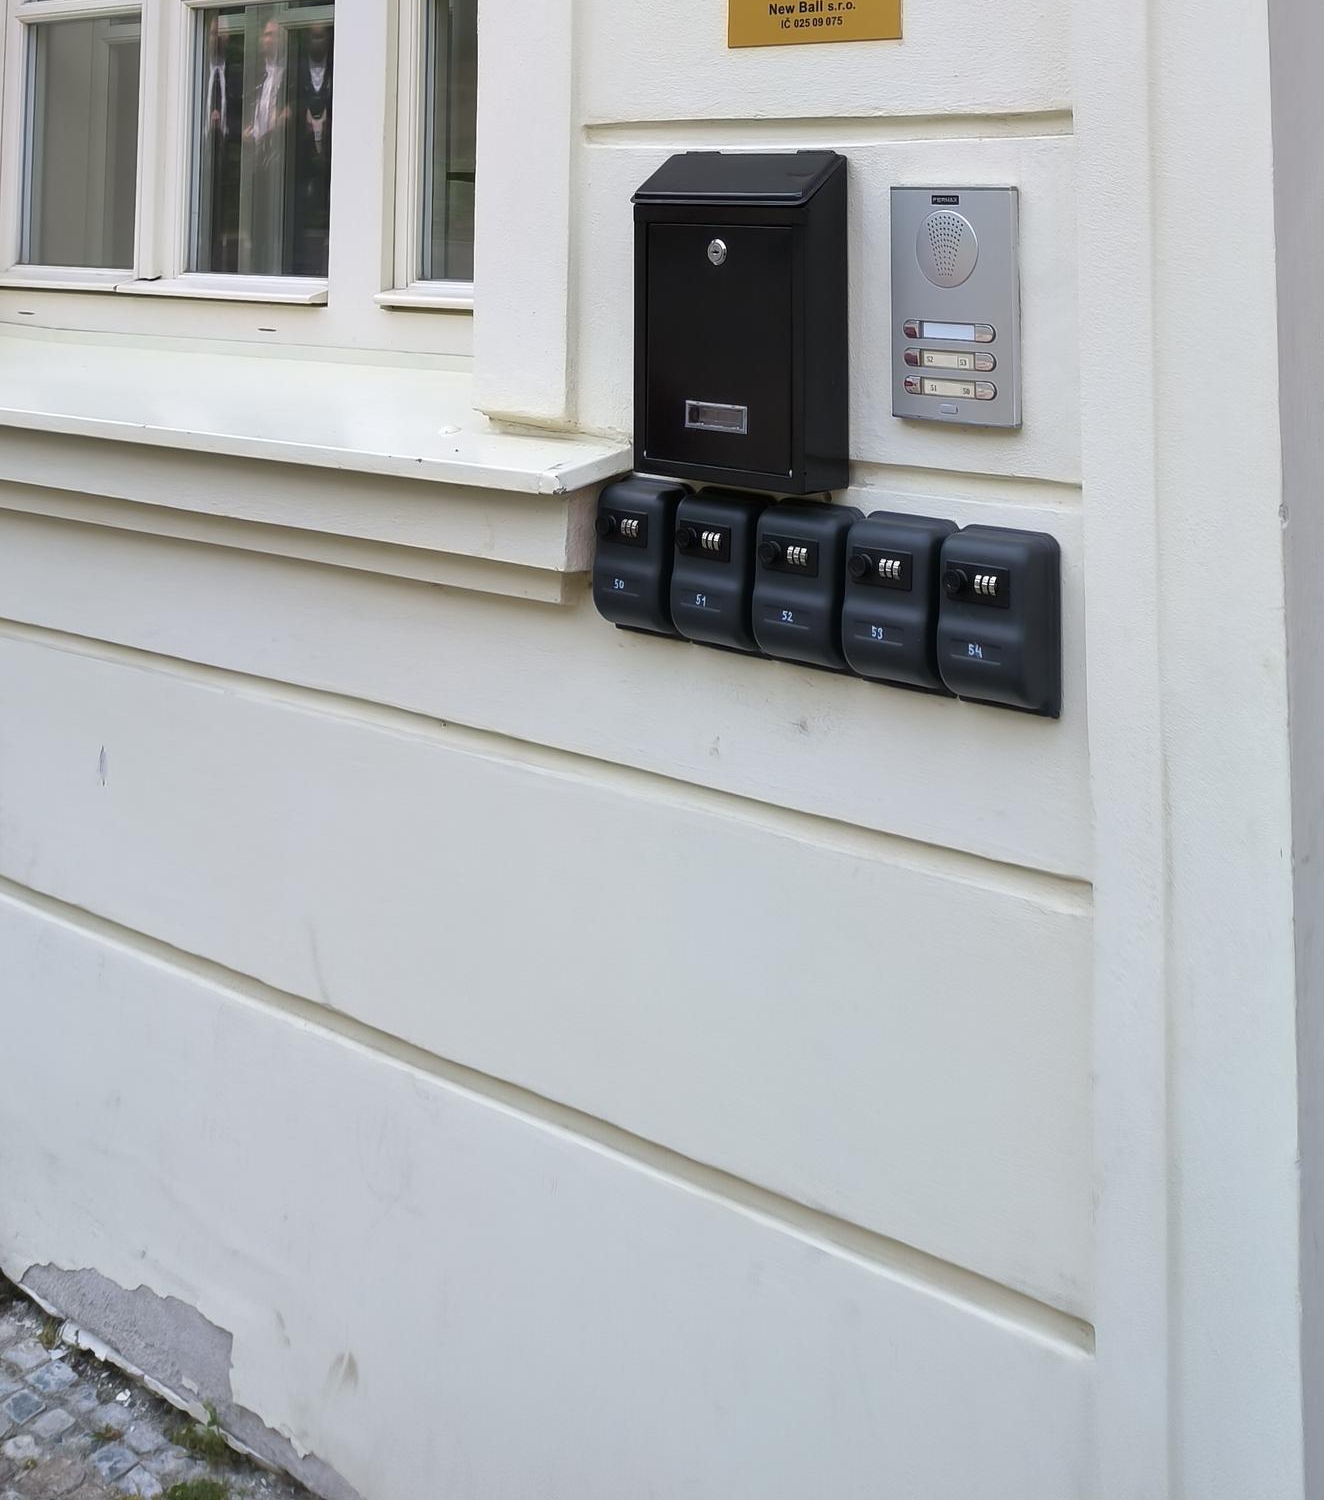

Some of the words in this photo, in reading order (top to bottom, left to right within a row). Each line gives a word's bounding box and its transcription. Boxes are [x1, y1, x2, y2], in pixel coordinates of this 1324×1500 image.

[769, 3, 796, 16] New
[799, 0, 823, 13] Ball
[827, 1, 856, 11] s.r.o.
[781, 17, 791, 29] IČ
[793, 18, 811, 28] 025
[812, 17, 824, 27] 09
[825, 16, 843, 26] 075
[613, 578, 625, 589] 50
[695, 593, 707, 607] 51
[782, 610, 793, 622] 52
[871, 625, 884, 640] 53
[968, 643, 983, 658] 54
